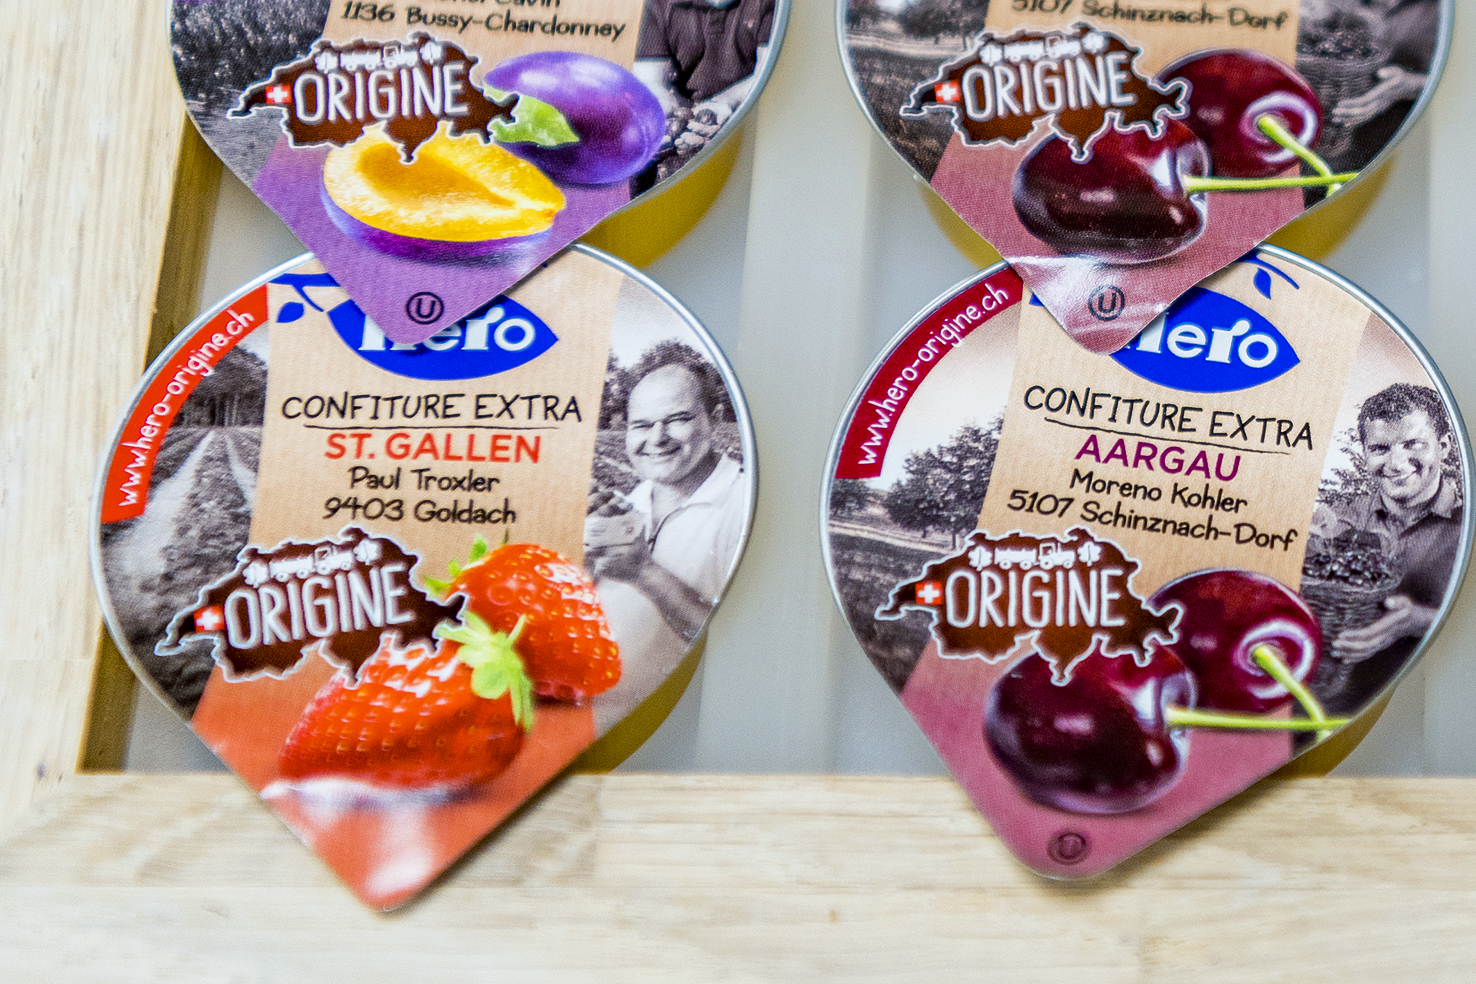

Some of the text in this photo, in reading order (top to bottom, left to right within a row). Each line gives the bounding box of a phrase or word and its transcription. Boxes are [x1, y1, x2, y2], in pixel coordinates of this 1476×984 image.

[341, 1, 626, 42] 1136 Bussy-Chardonney
[1080, 0, 1288, 31] Schinznach-Dorf
[295, 62, 469, 123] ORIGINE
[963, 52, 1136, 119] ORIGINE
[858, 284, 1008, 467] www.hero-origine.ch
[118, 307, 254, 508] www.hero-origine.ch
[282, 395, 581, 422] CONFITURE EXTRA
[1024, 385, 1313, 451] CONFITURE EXTRA
[324, 433, 541, 463] ST. GALLEN
[1075, 435, 1240, 481] AARGAU
[349, 467, 499, 493] Paul Troxler
[1069, 469, 1248, 513] Moreno Kohler
[324, 497, 517, 524] 9403 Goldach
[1008, 490, 1298, 551] 5107 Schinznach-Dorf
[224, 564, 415, 651] ORIGINE
[944, 569, 1125, 629] ORIGINE
